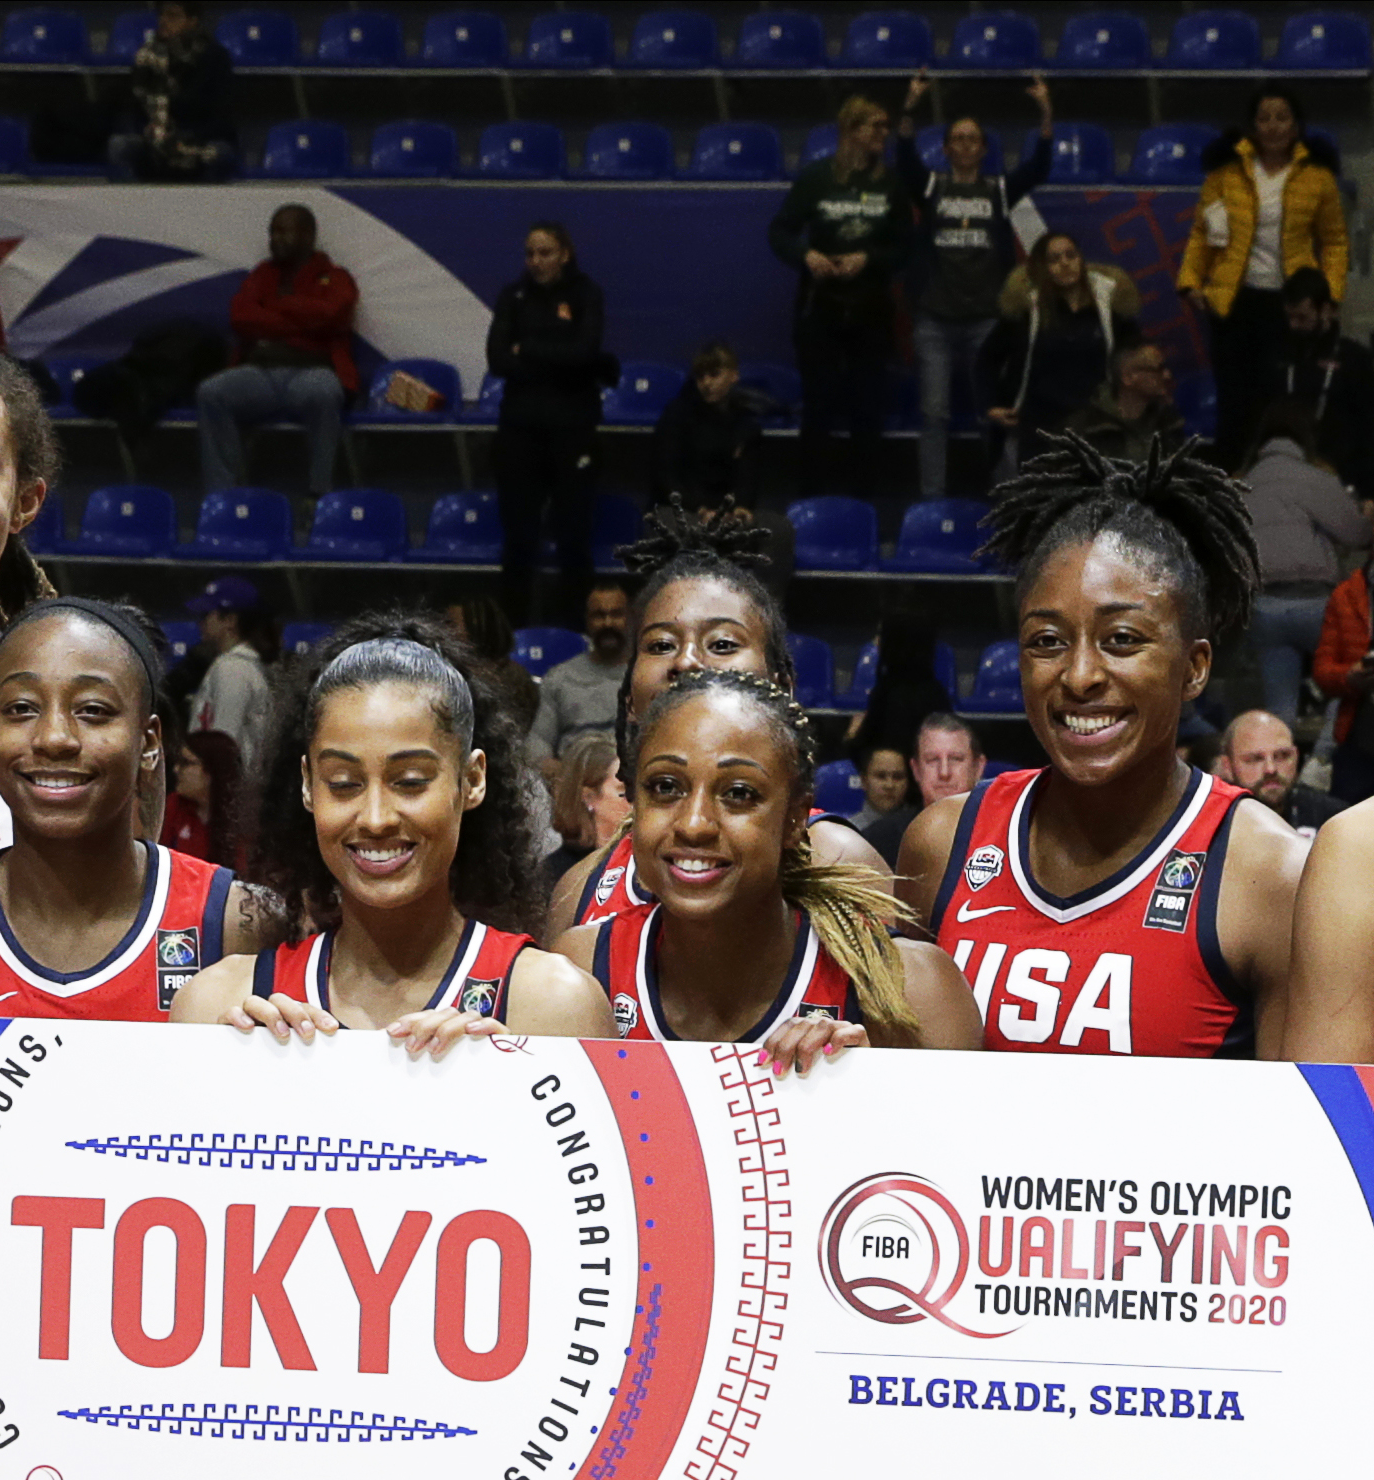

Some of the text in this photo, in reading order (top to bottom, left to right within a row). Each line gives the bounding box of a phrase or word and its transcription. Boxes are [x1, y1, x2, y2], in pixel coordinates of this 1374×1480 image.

[1154, 894, 1186, 911] FIBA
[953, 939, 1133, 1054] USA
[982, 1176, 1291, 1219] WOMEN'S OLYMPIC
[863, 1236, 909, 1258] FIBA
[11, 1195, 531, 1382] TOKYO
[975, 1284, 1286, 1326] TOURNAMENTS 2020
[848, 1375, 1244, 1421] BELGRADE, SERBIA
